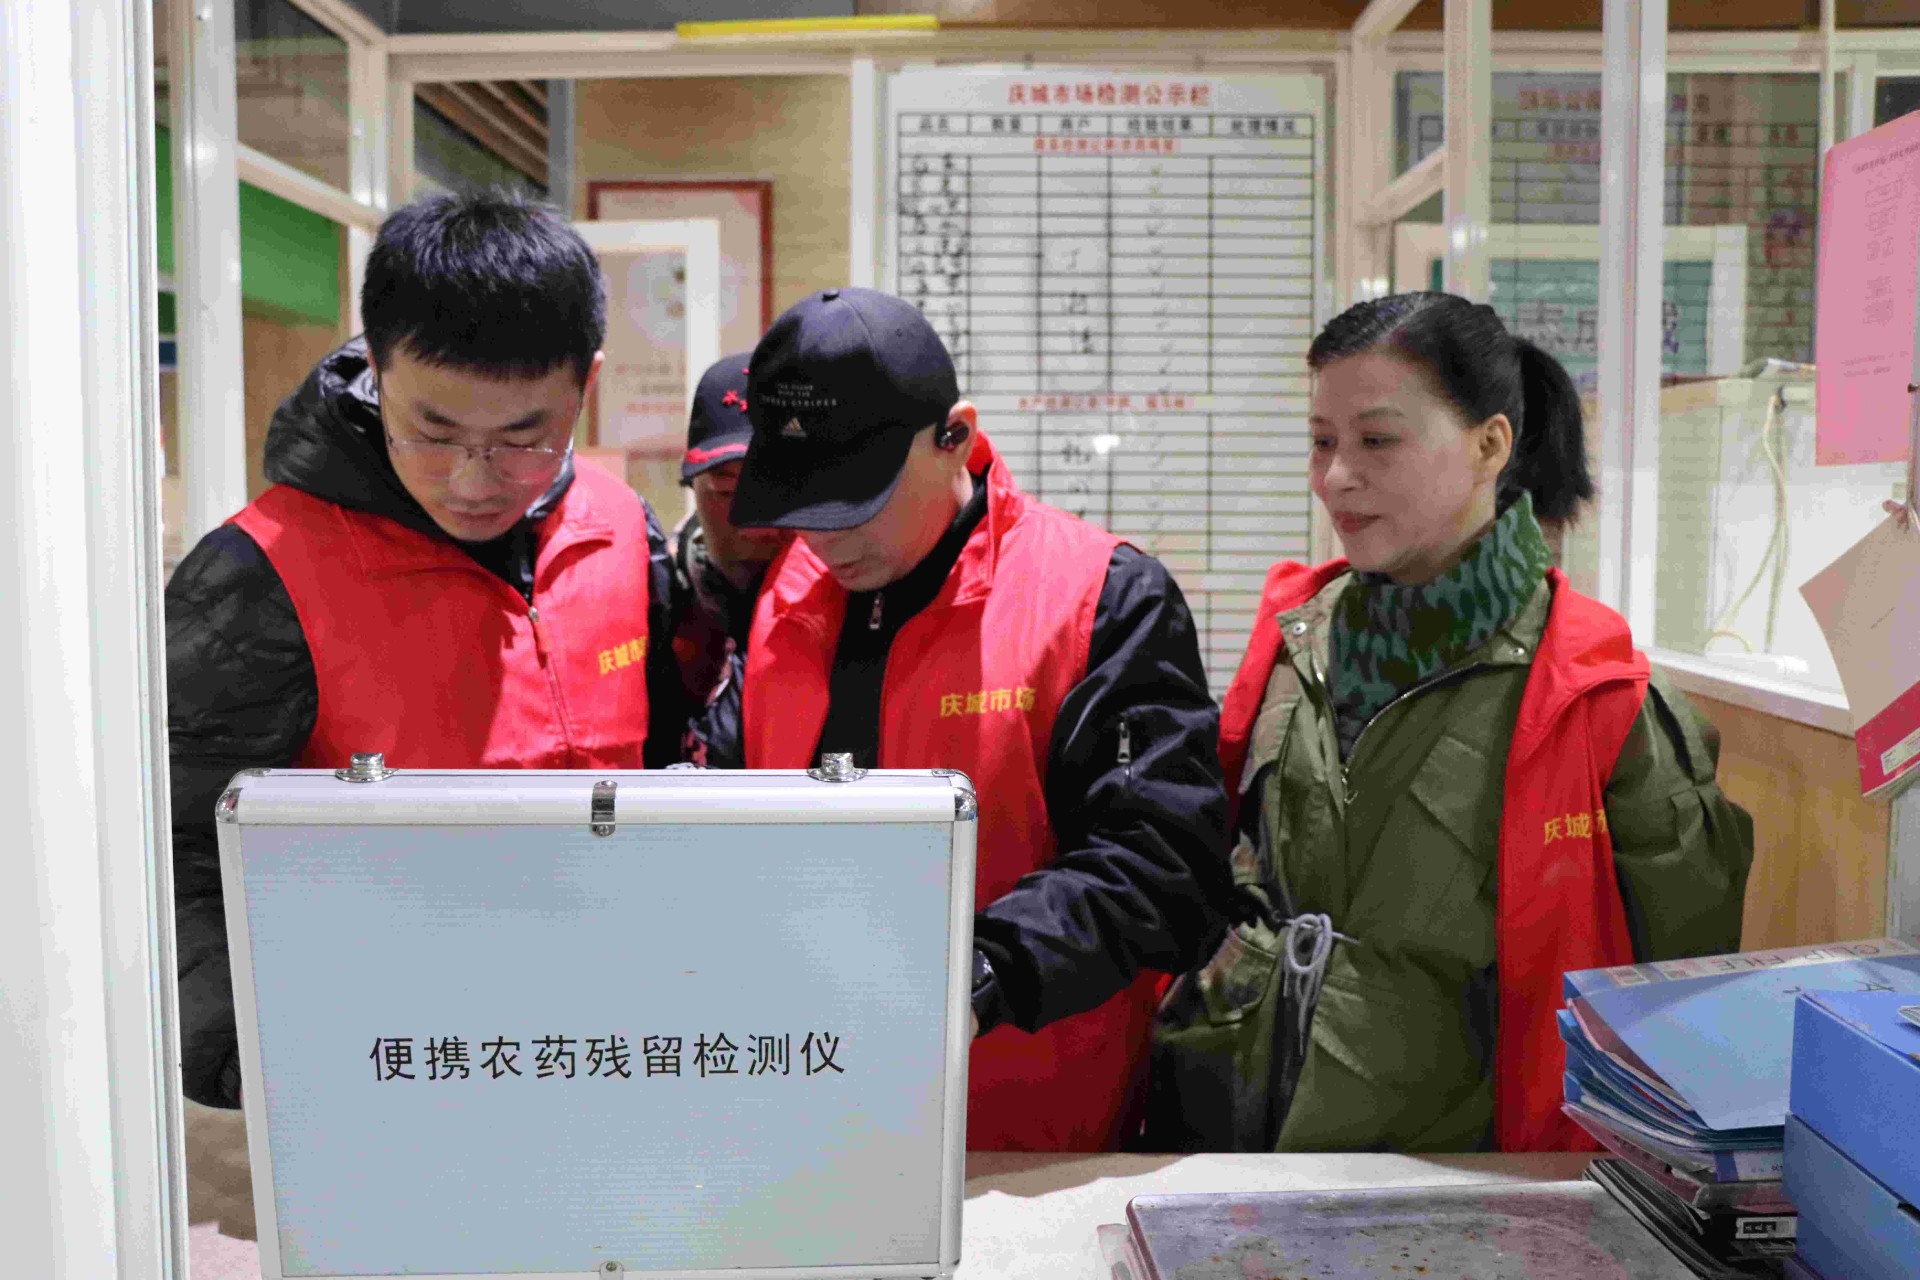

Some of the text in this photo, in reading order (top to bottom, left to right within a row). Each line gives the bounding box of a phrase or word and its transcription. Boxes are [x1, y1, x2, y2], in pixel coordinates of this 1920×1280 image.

[940, 686, 1036, 717] 庆城市场
[369, 1031, 846, 1081] 便携农药残留检测仪
